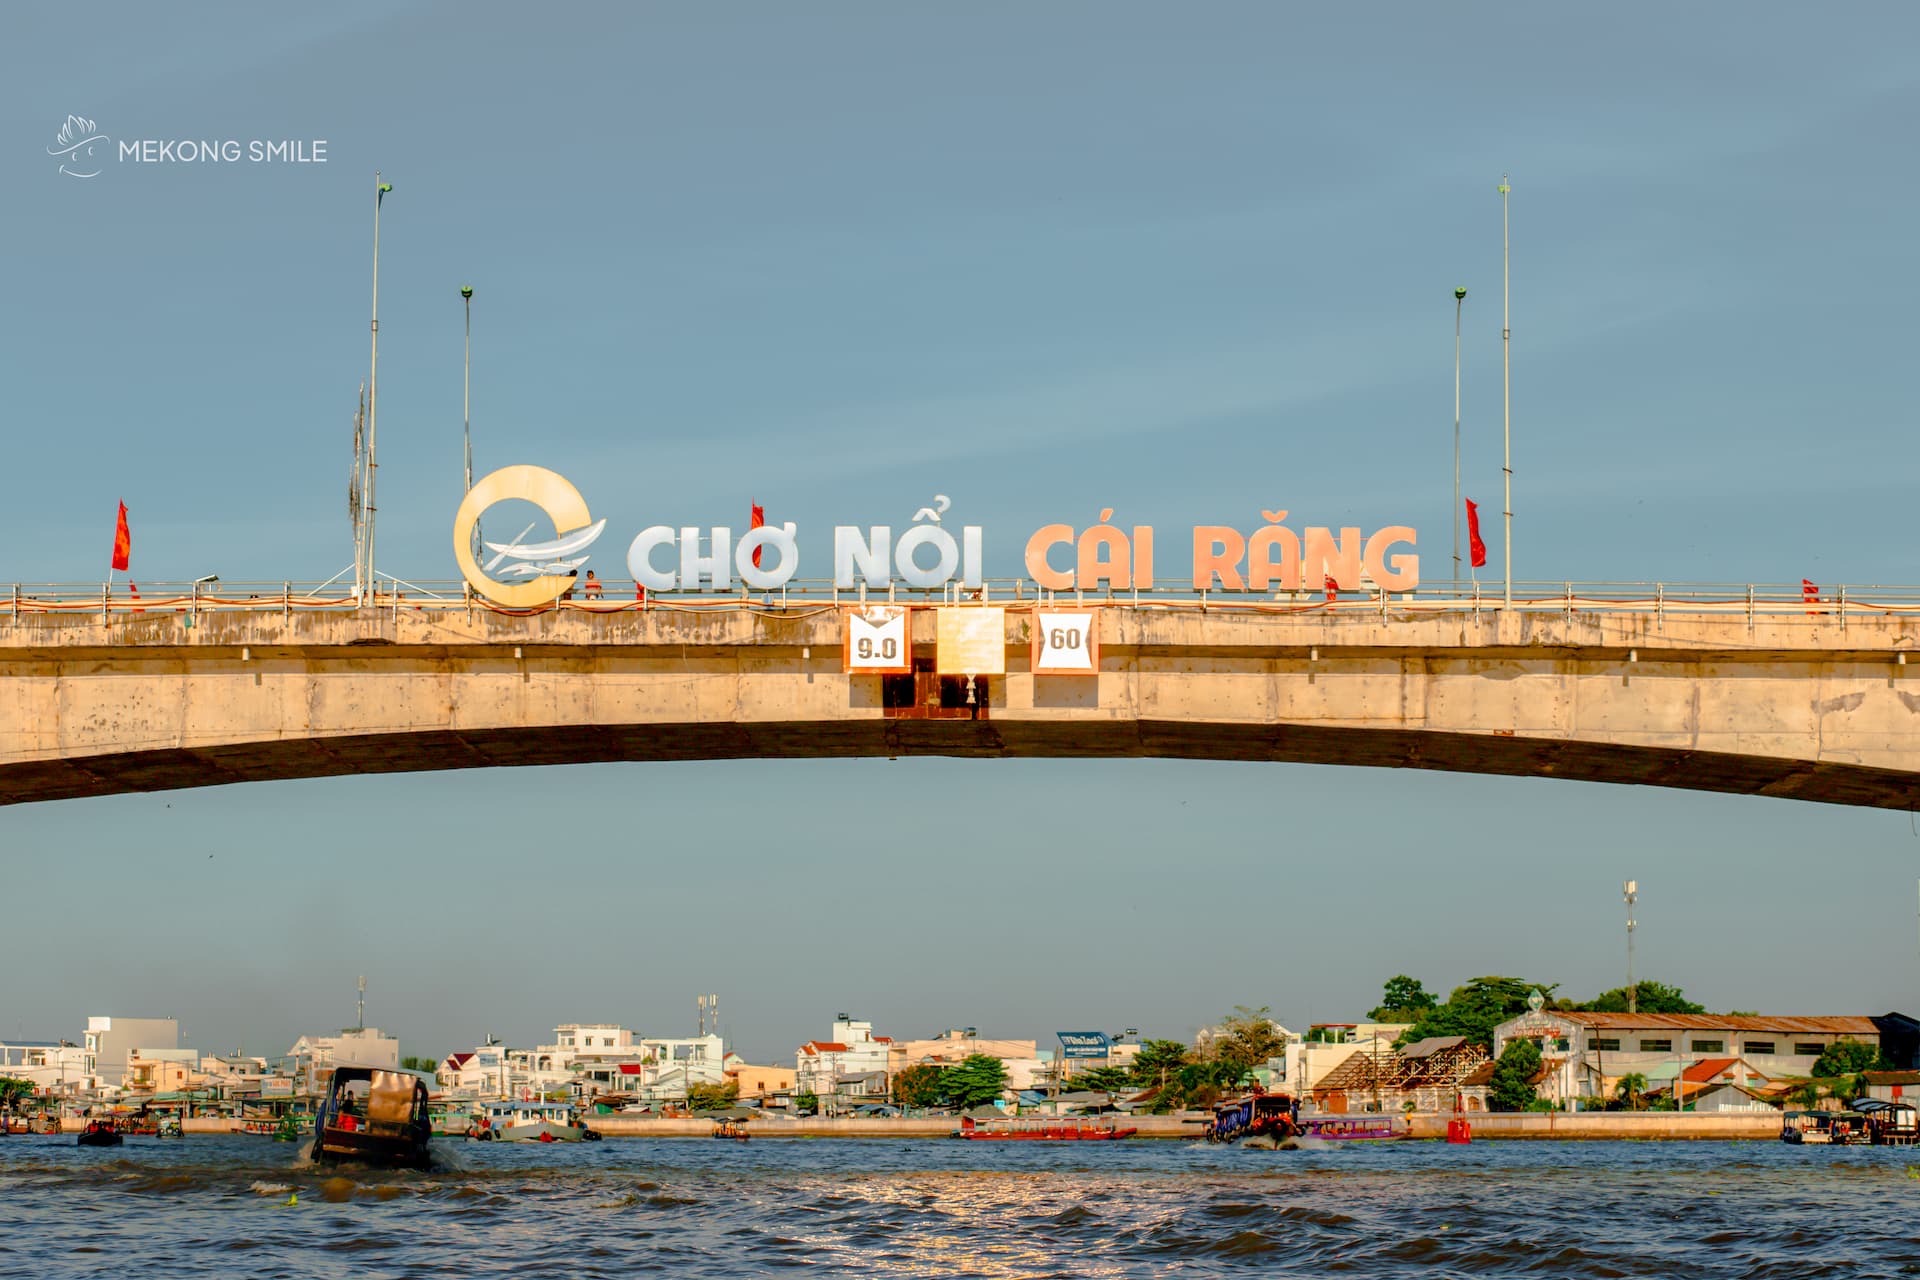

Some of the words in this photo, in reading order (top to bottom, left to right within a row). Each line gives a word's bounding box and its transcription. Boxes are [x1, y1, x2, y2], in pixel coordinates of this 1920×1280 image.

[834, 494, 983, 590] NỔI
[1024, 508, 1154, 591] CÁI
[1192, 510, 1420, 593] RĂNG
[858, 637, 897, 660] 9.0
[1050, 628, 1081, 650] 60
